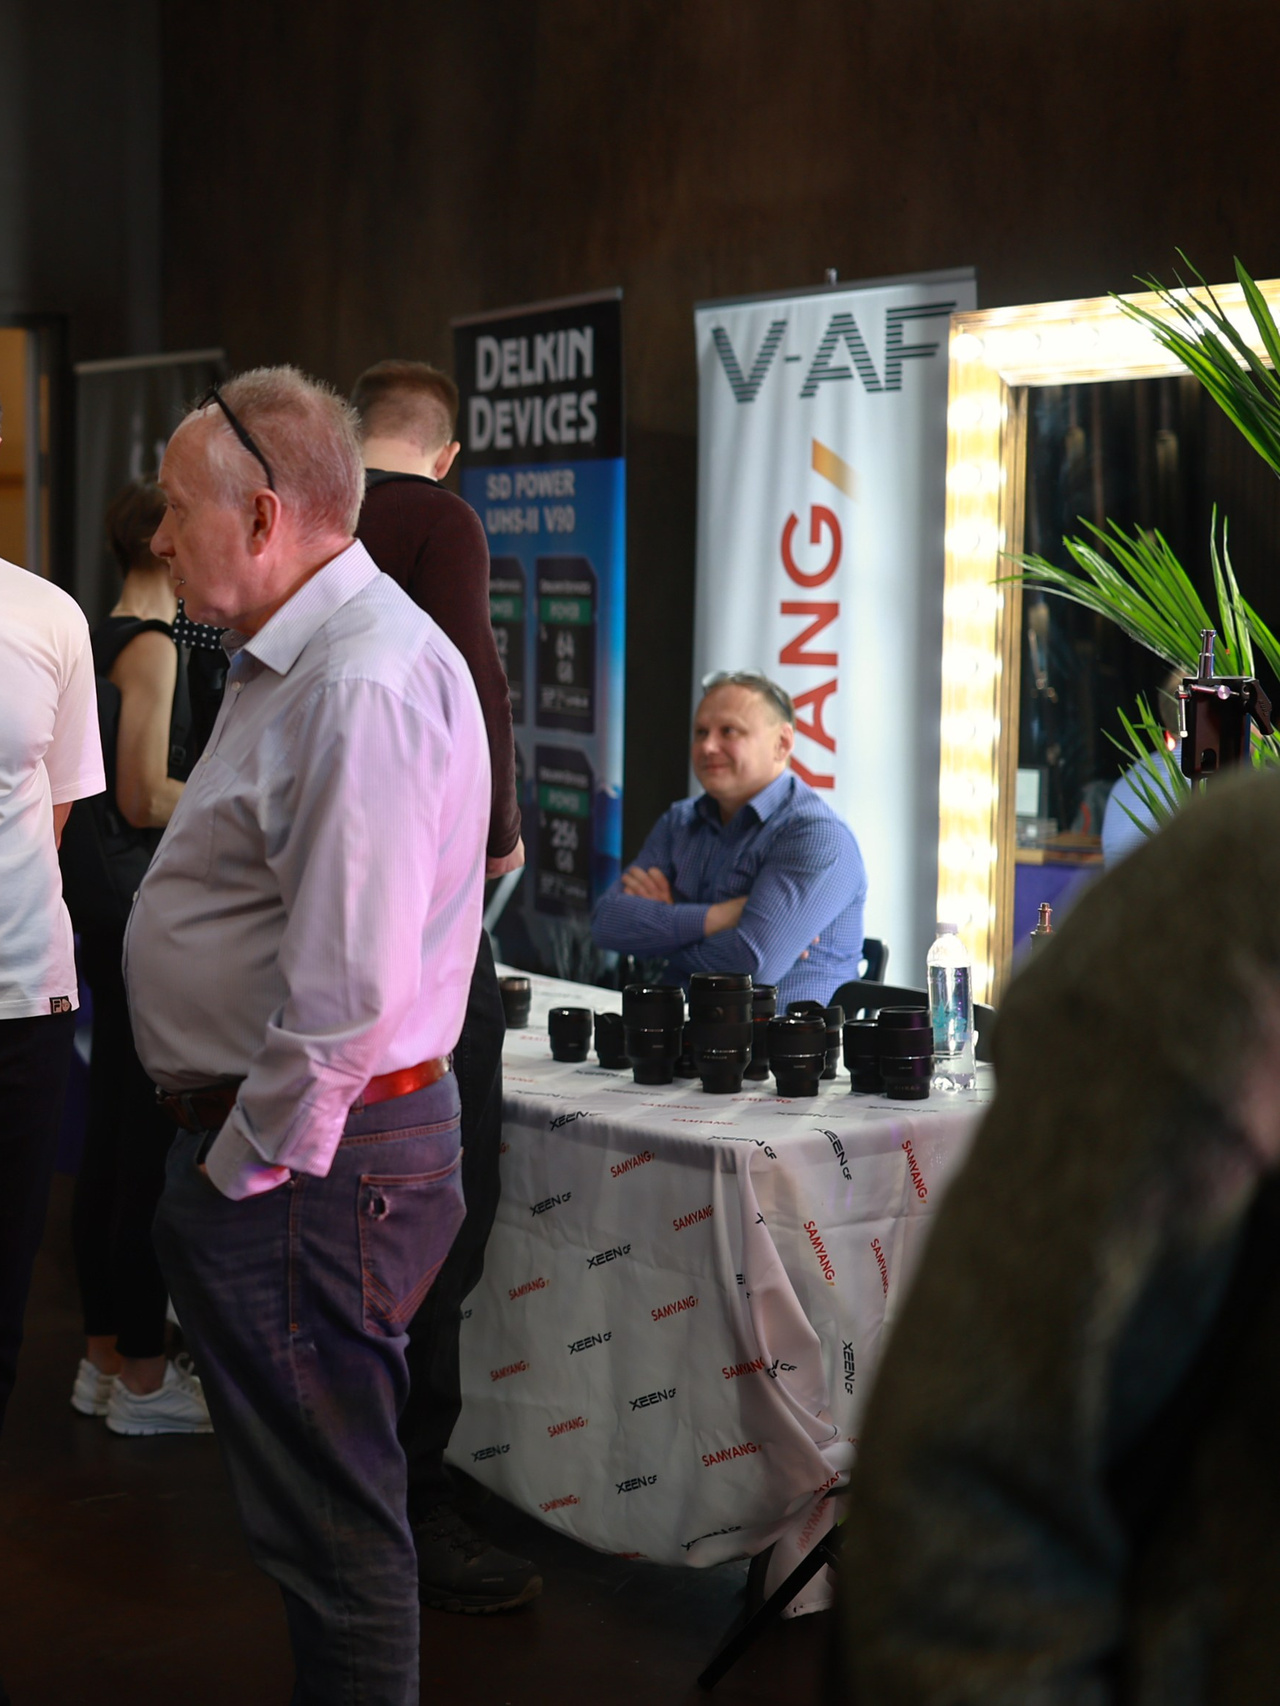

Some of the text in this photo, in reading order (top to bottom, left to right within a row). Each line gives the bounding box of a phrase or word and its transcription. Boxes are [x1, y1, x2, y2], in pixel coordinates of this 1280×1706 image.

[476, 325, 594, 392] DELKIN
[711, 301, 957, 402] V-AF
[469, 389, 598, 452] DEVICES
[486, 469, 576, 500] SD POWER
[549, 1110, 589, 1131] XEEN
[610, 1150, 653, 1178] SAMYANG
[901, 1140, 928, 1198] SAMYANG
[529, 1194, 562, 1217] XEEN
[672, 1204, 715, 1231] SAMYANG
[586, 1246, 623, 1269] XEEN
[803, 1220, 836, 1281] SAMYANG
[508, 1277, 546, 1301] SAMYANG
[651, 1295, 696, 1322] SAMYANG
[567, 1333, 602, 1355] XEEN
[490, 1360, 527, 1382] SAMYANG
[842, 1340, 855, 1381] XEEN
[629, 1389, 669, 1411] XEEN
[547, 1416, 586, 1438] SAMYANG
[471, 1445, 502, 1463] XEEN
[701, 1442, 757, 1467] SAMYANG
[615, 1475, 648, 1495] XEEN
